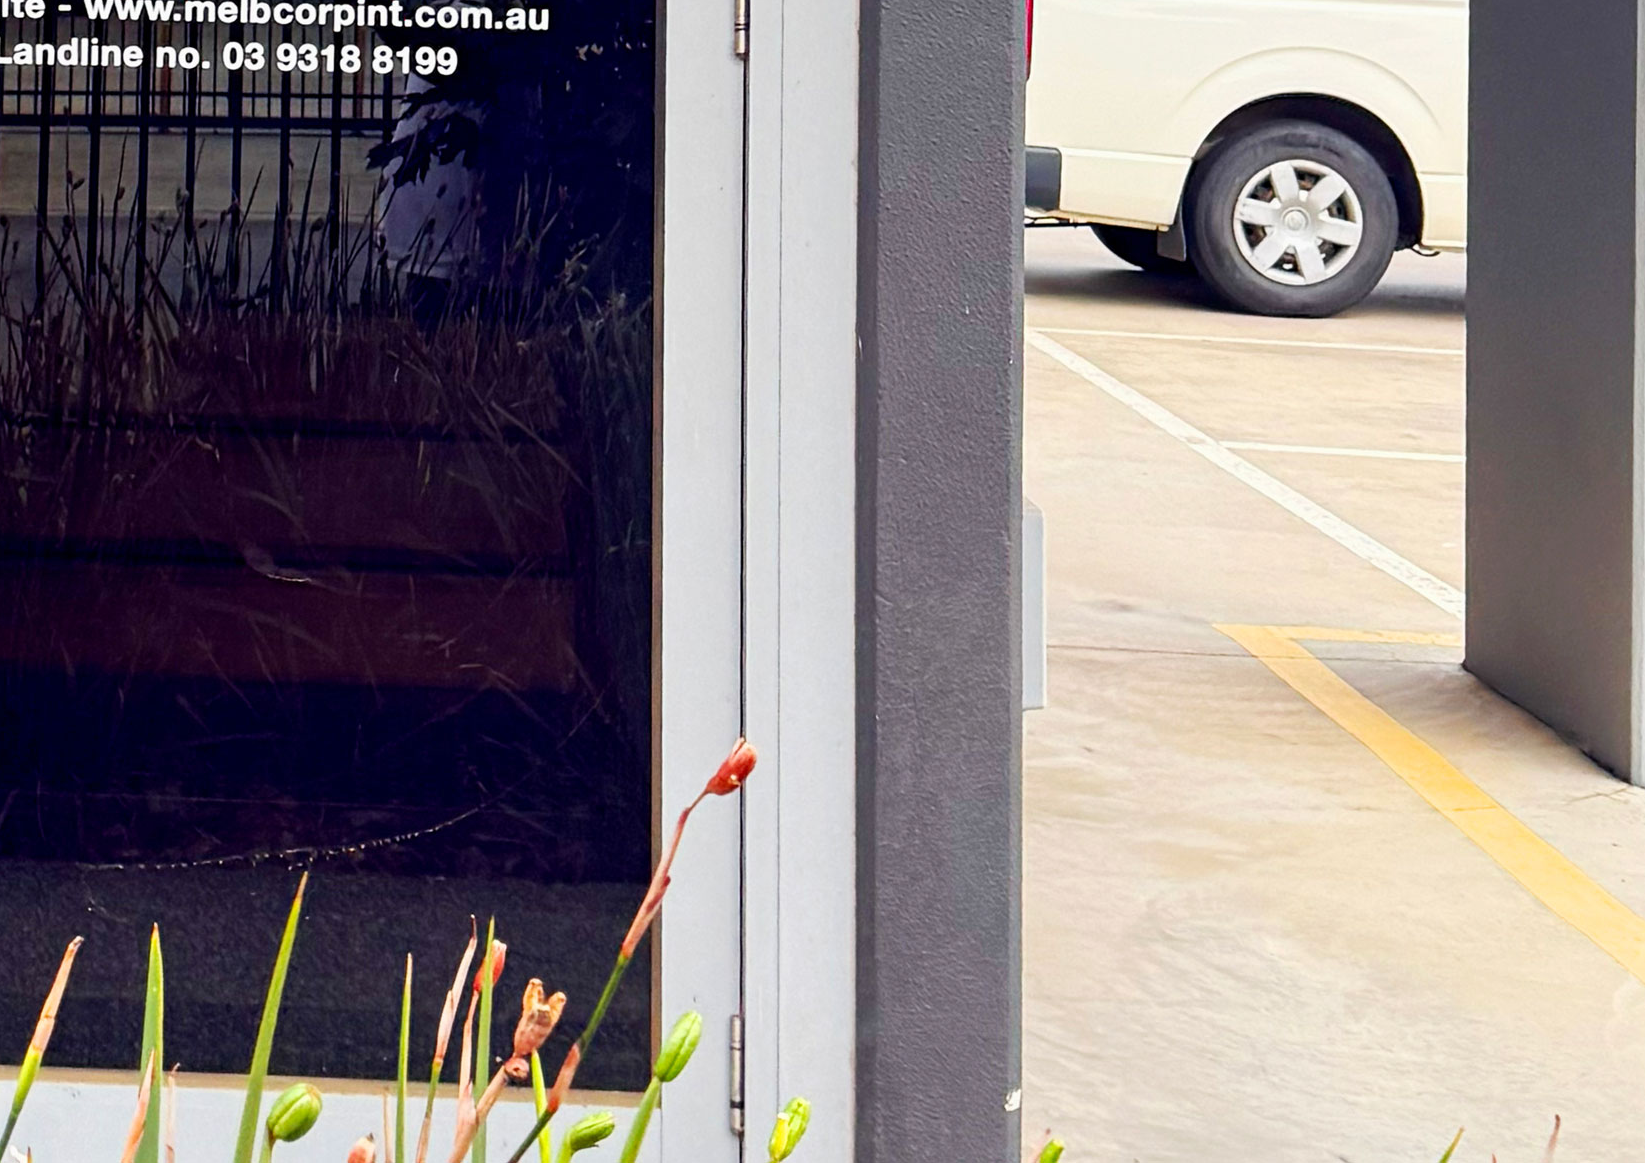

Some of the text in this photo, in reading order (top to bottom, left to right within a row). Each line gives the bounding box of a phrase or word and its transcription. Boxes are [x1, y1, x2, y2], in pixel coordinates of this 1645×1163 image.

[156, 46, 211, 69] no.
[222, 41, 266, 71] 03
[276, 42, 361, 74] 9318
[372, 45, 458, 76] 8199
